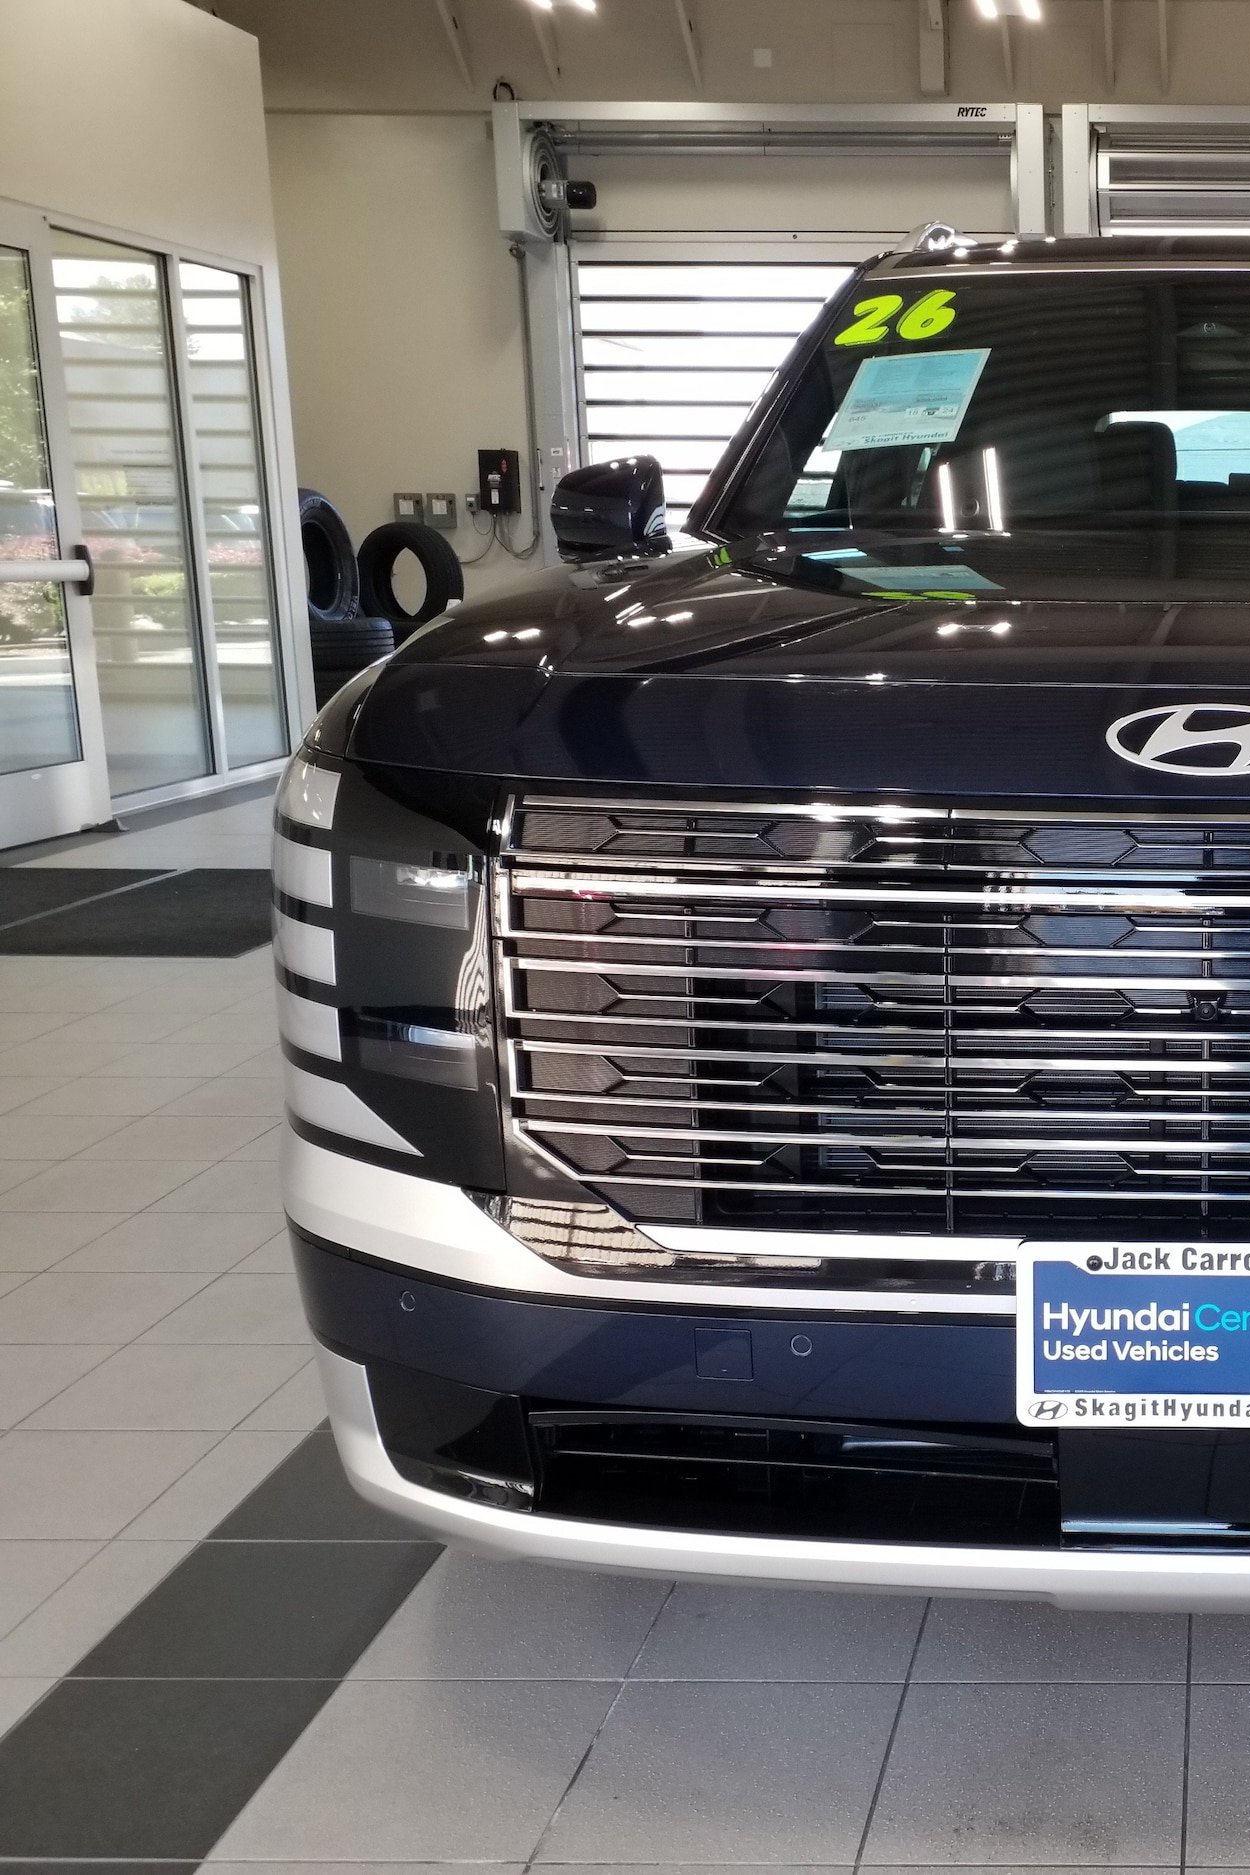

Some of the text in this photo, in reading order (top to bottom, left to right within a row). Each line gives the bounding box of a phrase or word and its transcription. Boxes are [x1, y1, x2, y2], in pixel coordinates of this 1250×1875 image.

[957, 107, 987, 117] RYTEC
[834, 289, 957, 346] 26
[902, 431, 949, 442] Hyundai
[1104, 1247, 1170, 1271] Jack
[1043, 1302, 1190, 1336] Hyundai
[1043, 1340, 1219, 1362] Used Vehicles
